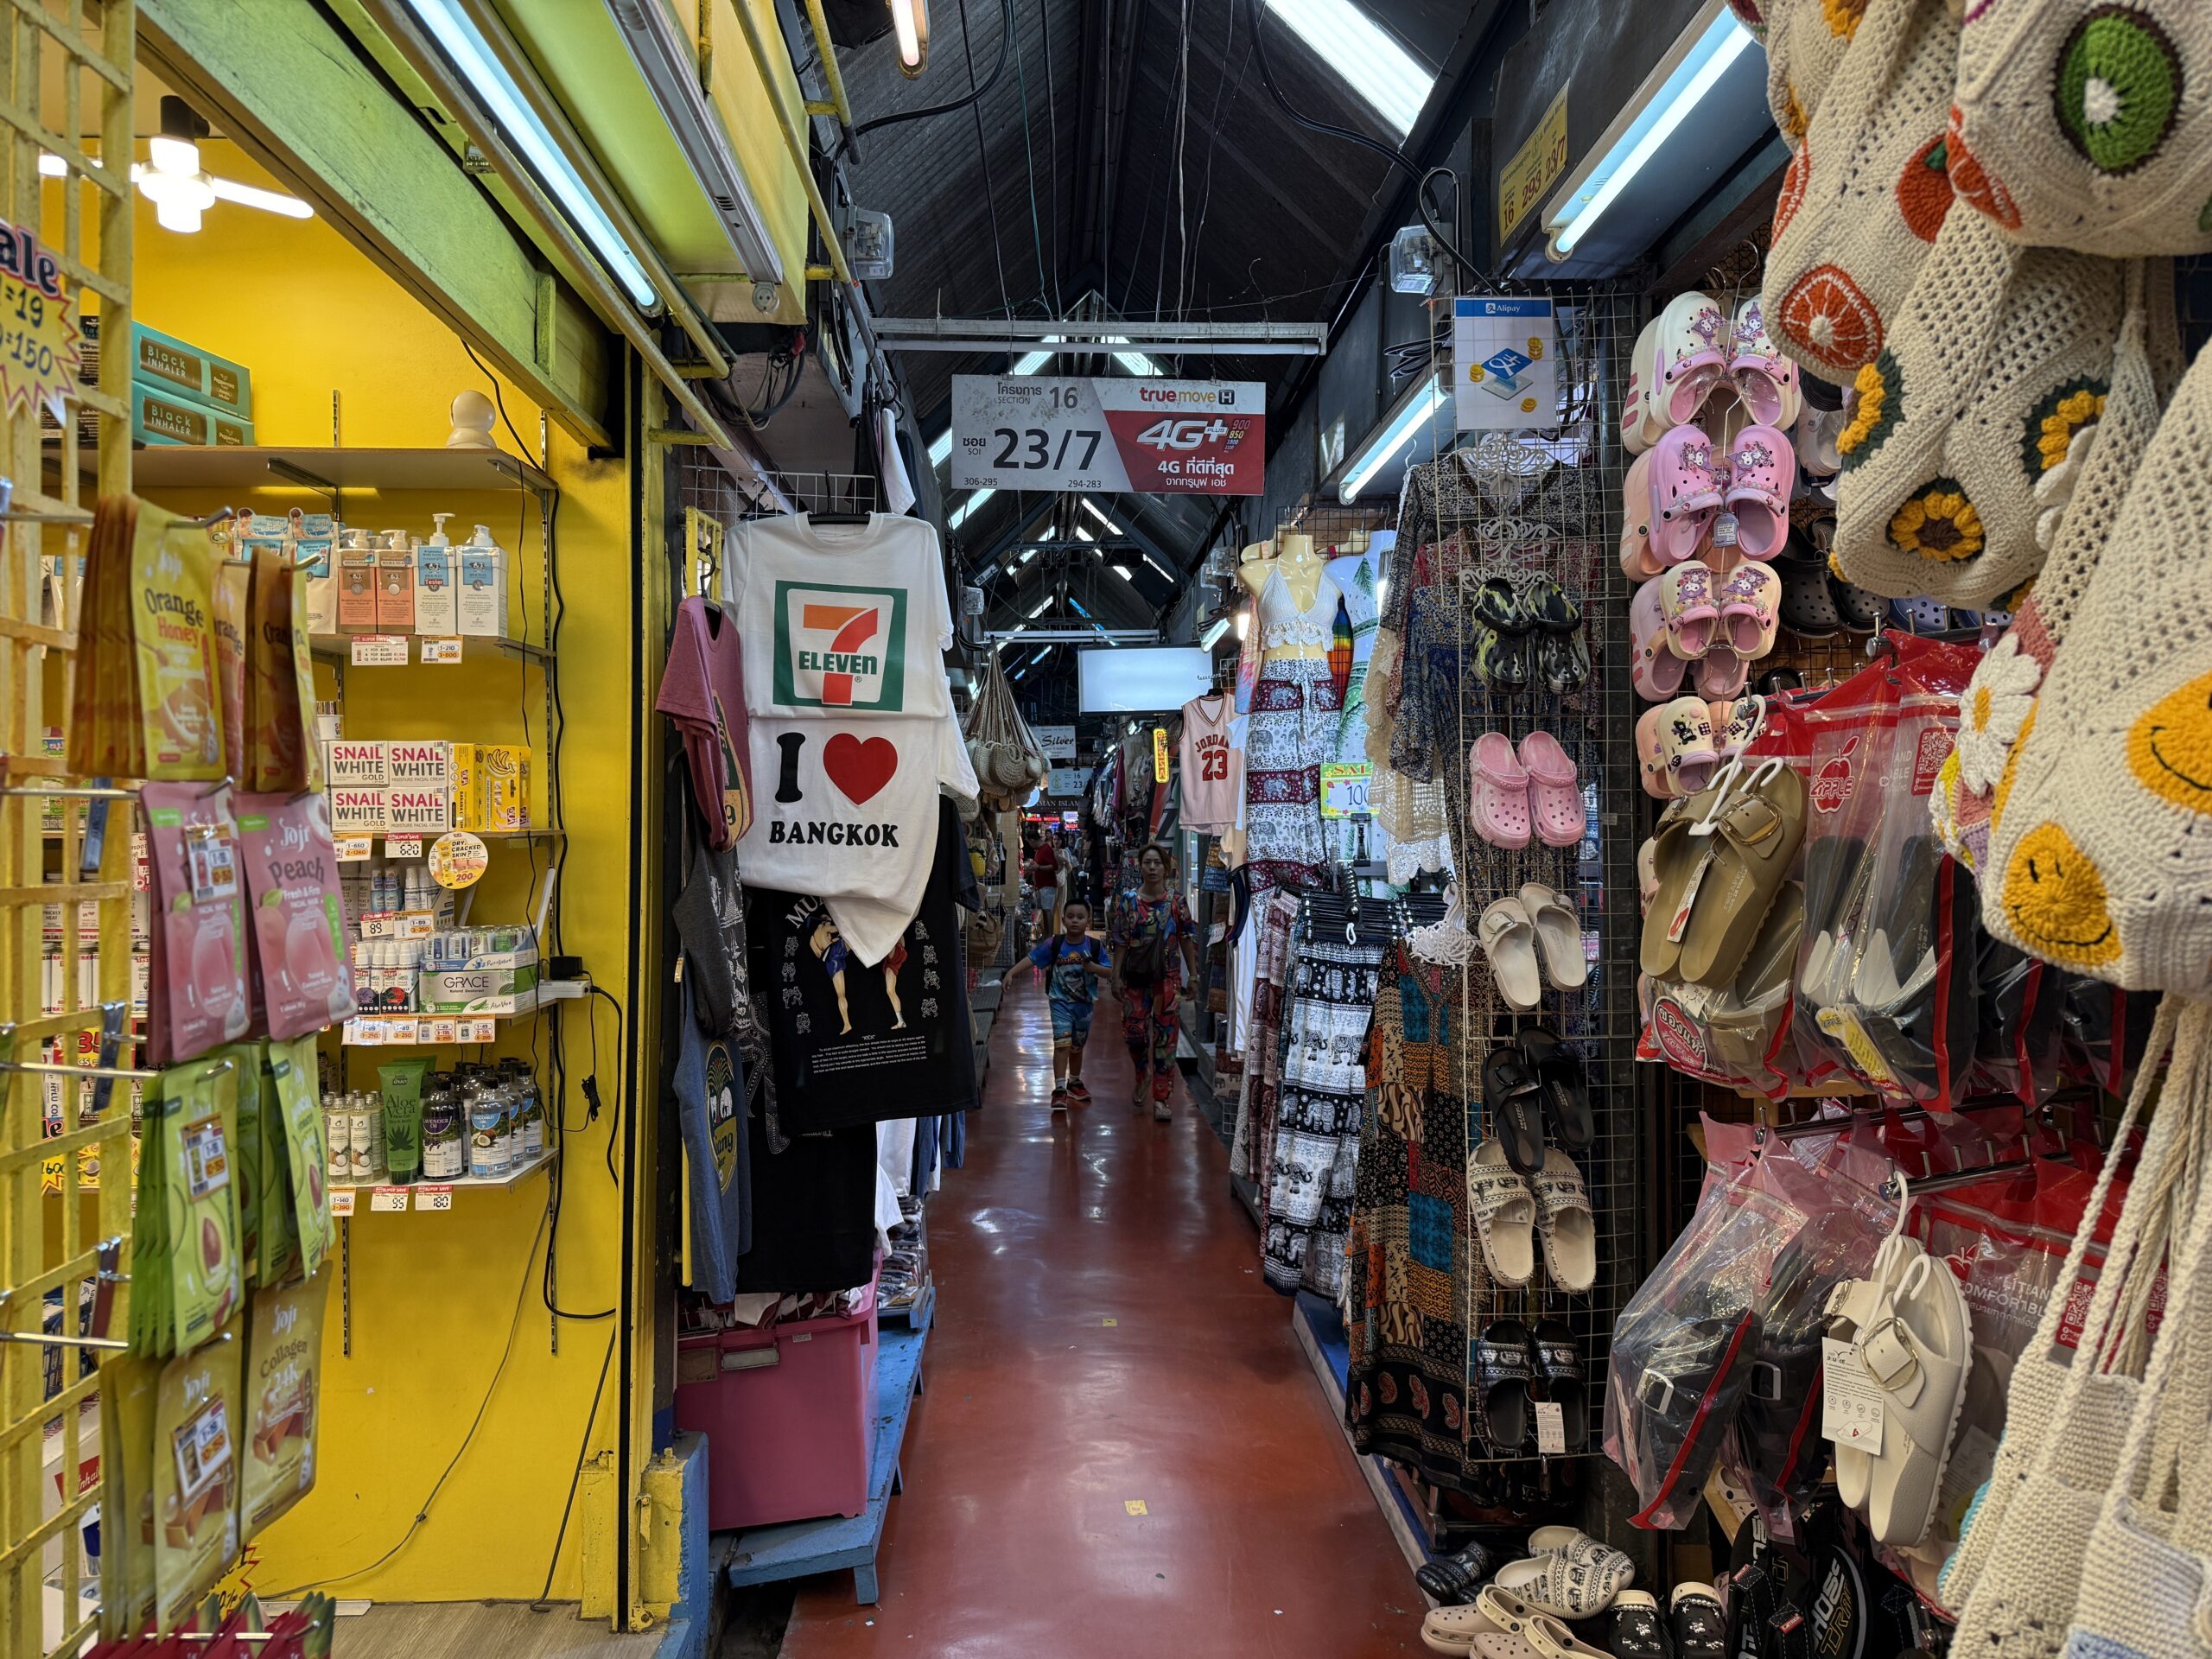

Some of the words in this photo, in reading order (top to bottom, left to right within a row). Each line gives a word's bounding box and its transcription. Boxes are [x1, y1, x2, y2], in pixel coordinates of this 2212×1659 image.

[0, 226, 58, 294] ale
[1497, 304, 1521, 313] Alipay
[148, 345, 186, 369] Black
[148, 358, 186, 378] INHALER
[997, 382, 1042, 395] โครงการ
[1049, 386, 1078, 409] 16
[151, 404, 191, 427] Black
[151, 416, 191, 435] INHALER
[1232, 419, 1251, 430] 900
[1229, 430, 1244, 439] 850
[963, 437, 987, 448] ซอย
[993, 428, 1102, 471] 23/7
[968, 448, 982, 456] SOI
[1158, 461, 1180, 474] 4G
[1185, 456, 1235, 479] ที่ดีที่สุด
[963, 477, 998, 486] 306-295
[1067, 479, 1102, 488] 294-283
[143, 588, 205, 627] Orange
[157, 616, 200, 648] Honey
[213, 619, 244, 656] range
[263, 621, 293, 646] Oran
[803, 603, 879, 705] 7
[1041, 734, 1075, 747] Silver
[334, 747, 384, 760] SNAIL
[391, 747, 444, 761] SNAIL
[334, 761, 384, 774] WHITE
[391, 762, 445, 777] WHITE
[774, 732, 806, 804] I
[1201, 749, 1228, 782] 23
[1333, 765, 1373, 775] SAL
[1073, 780, 1086, 789] 23/
[335, 793, 385, 806] SNAIL
[391, 793, 443, 807] SNAIL
[335, 807, 385, 820] WHITE
[391, 809, 444, 822] WHITE
[769, 821, 899, 849] BANGKOK
[399, 844, 420, 856] 620
[268, 856, 325, 889] Peach
[785, 893, 823, 930] MU
[369, 922, 382, 934] 89
[443, 976, 489, 988] GRACE
[386, 1094, 416, 1108] Aloe
[388, 1105, 416, 1118] Vera
[41, 1116, 63, 1141] le
[392, 1198, 404, 1209] 95
[2030, 1284, 2051, 1300] AN
[261, 1338, 308, 1379] Collagen
